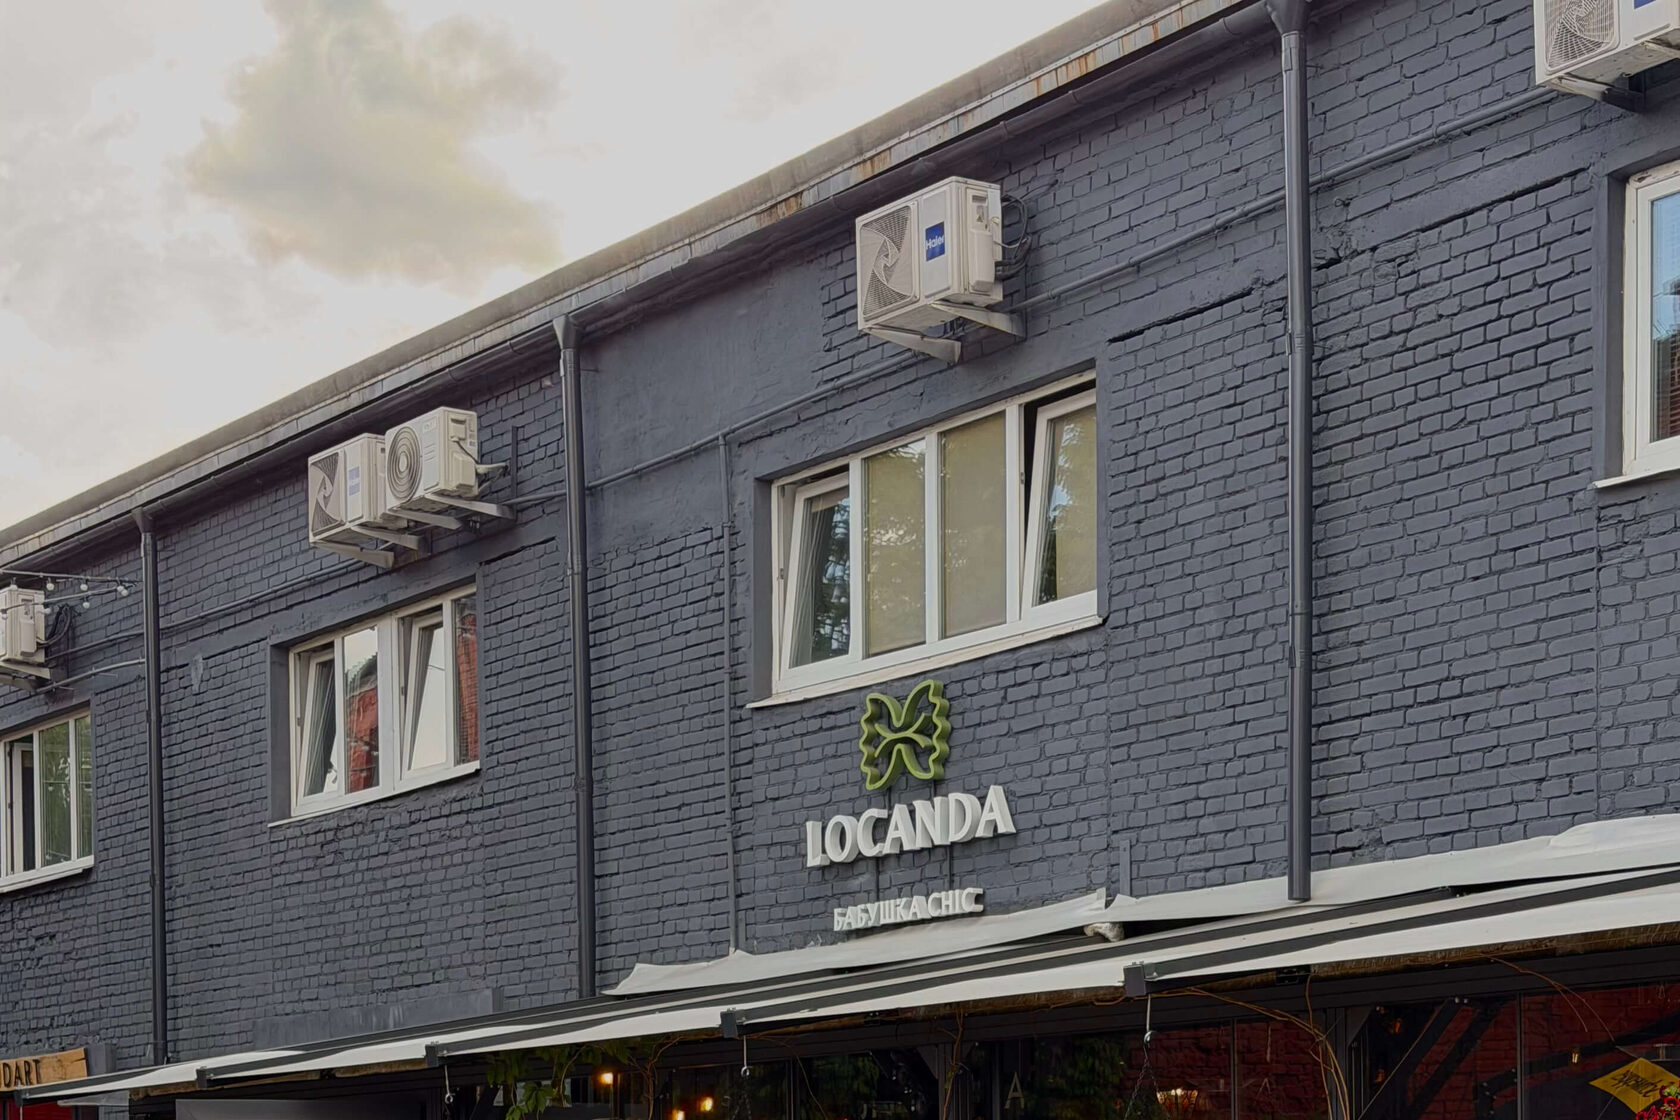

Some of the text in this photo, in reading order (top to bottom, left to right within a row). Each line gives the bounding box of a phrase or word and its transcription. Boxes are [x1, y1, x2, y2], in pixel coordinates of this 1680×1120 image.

[925, 235, 945, 250] Haier
[806, 785, 1016, 868] LOCANDA
[833, 895, 932, 932] БАБУШКА
